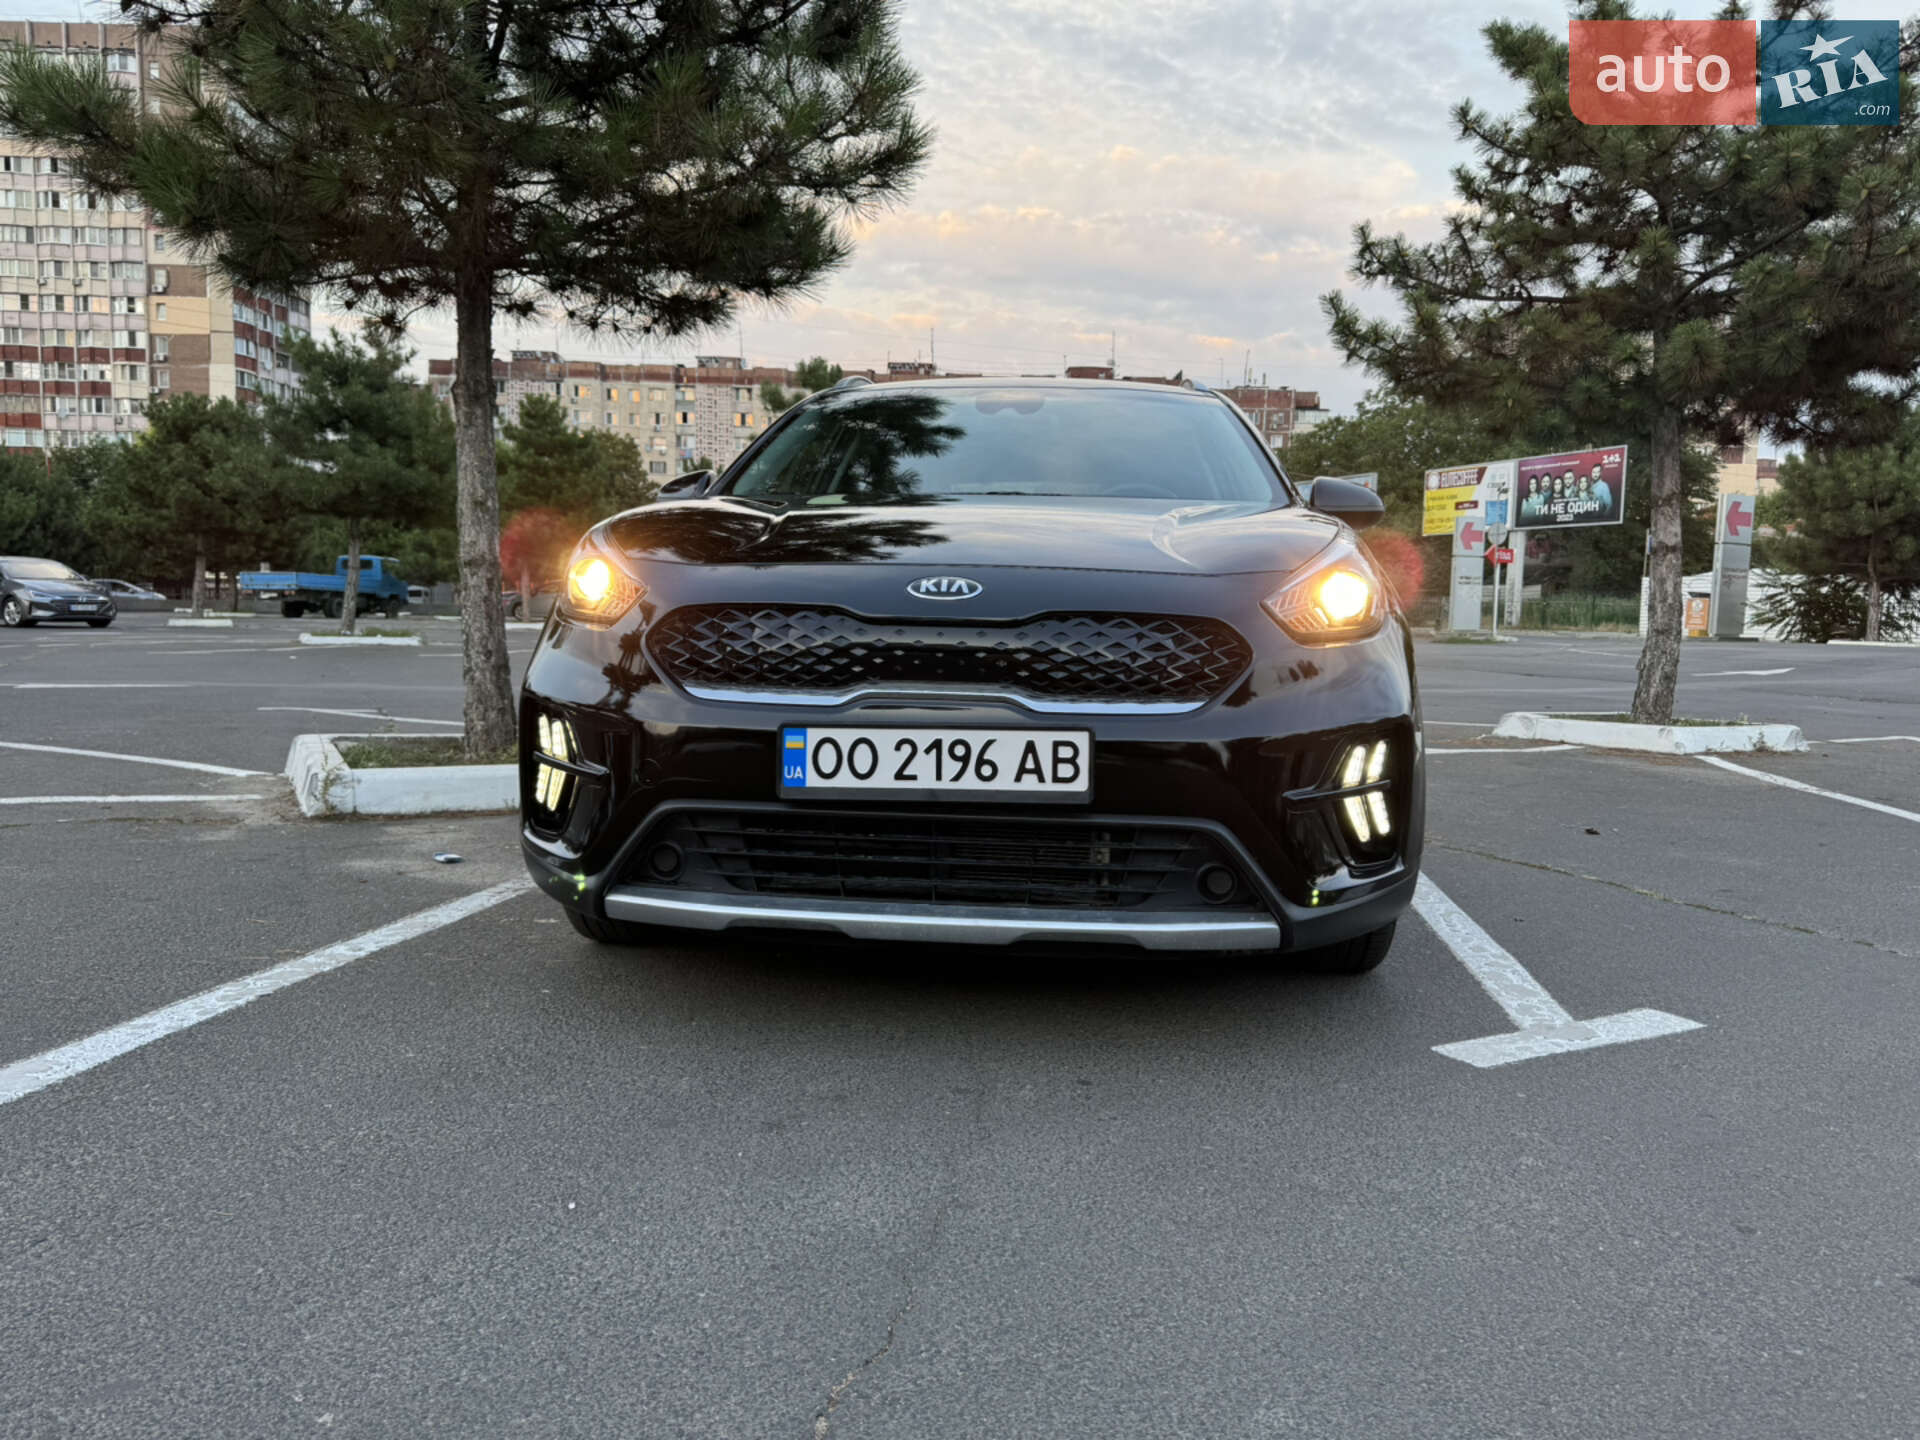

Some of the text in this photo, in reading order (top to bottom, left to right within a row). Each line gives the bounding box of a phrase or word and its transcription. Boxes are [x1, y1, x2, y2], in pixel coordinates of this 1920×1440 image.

[1535, 500, 1600, 516] ТИ НЕ ОДИН
[919, 578, 970, 593] KIA
[812, 737, 1081, 784] OO 2196 AB
[784, 766, 804, 779] UA
